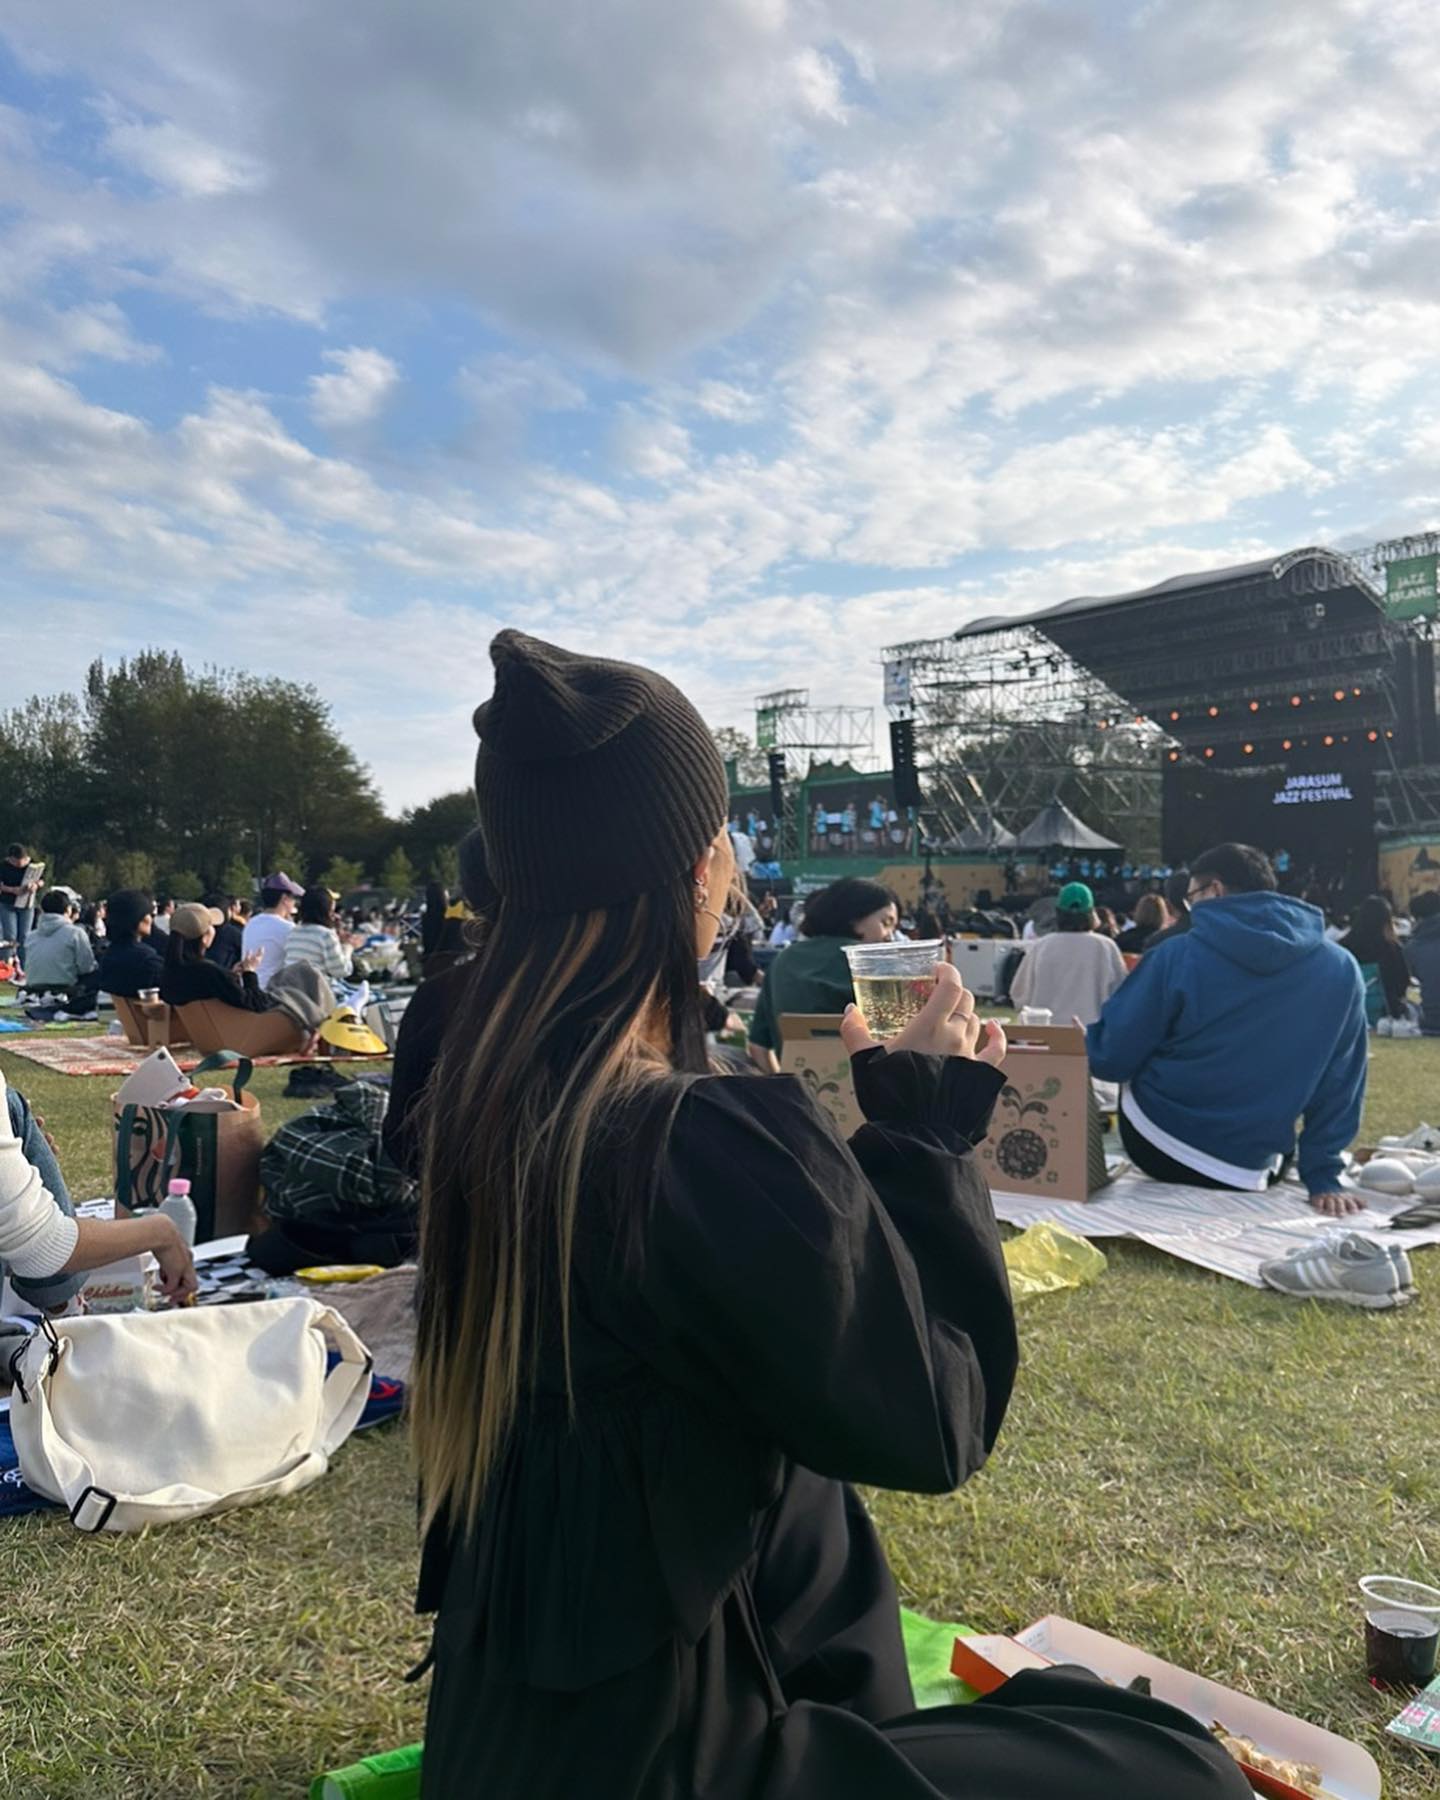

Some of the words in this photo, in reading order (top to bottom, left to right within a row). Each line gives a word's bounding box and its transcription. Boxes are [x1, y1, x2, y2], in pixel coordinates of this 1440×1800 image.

[1285, 773, 1342, 790] JARASUM
[1272, 790, 1300, 804] JAZZ
[1301, 787, 1353, 802] FESTIVAL
